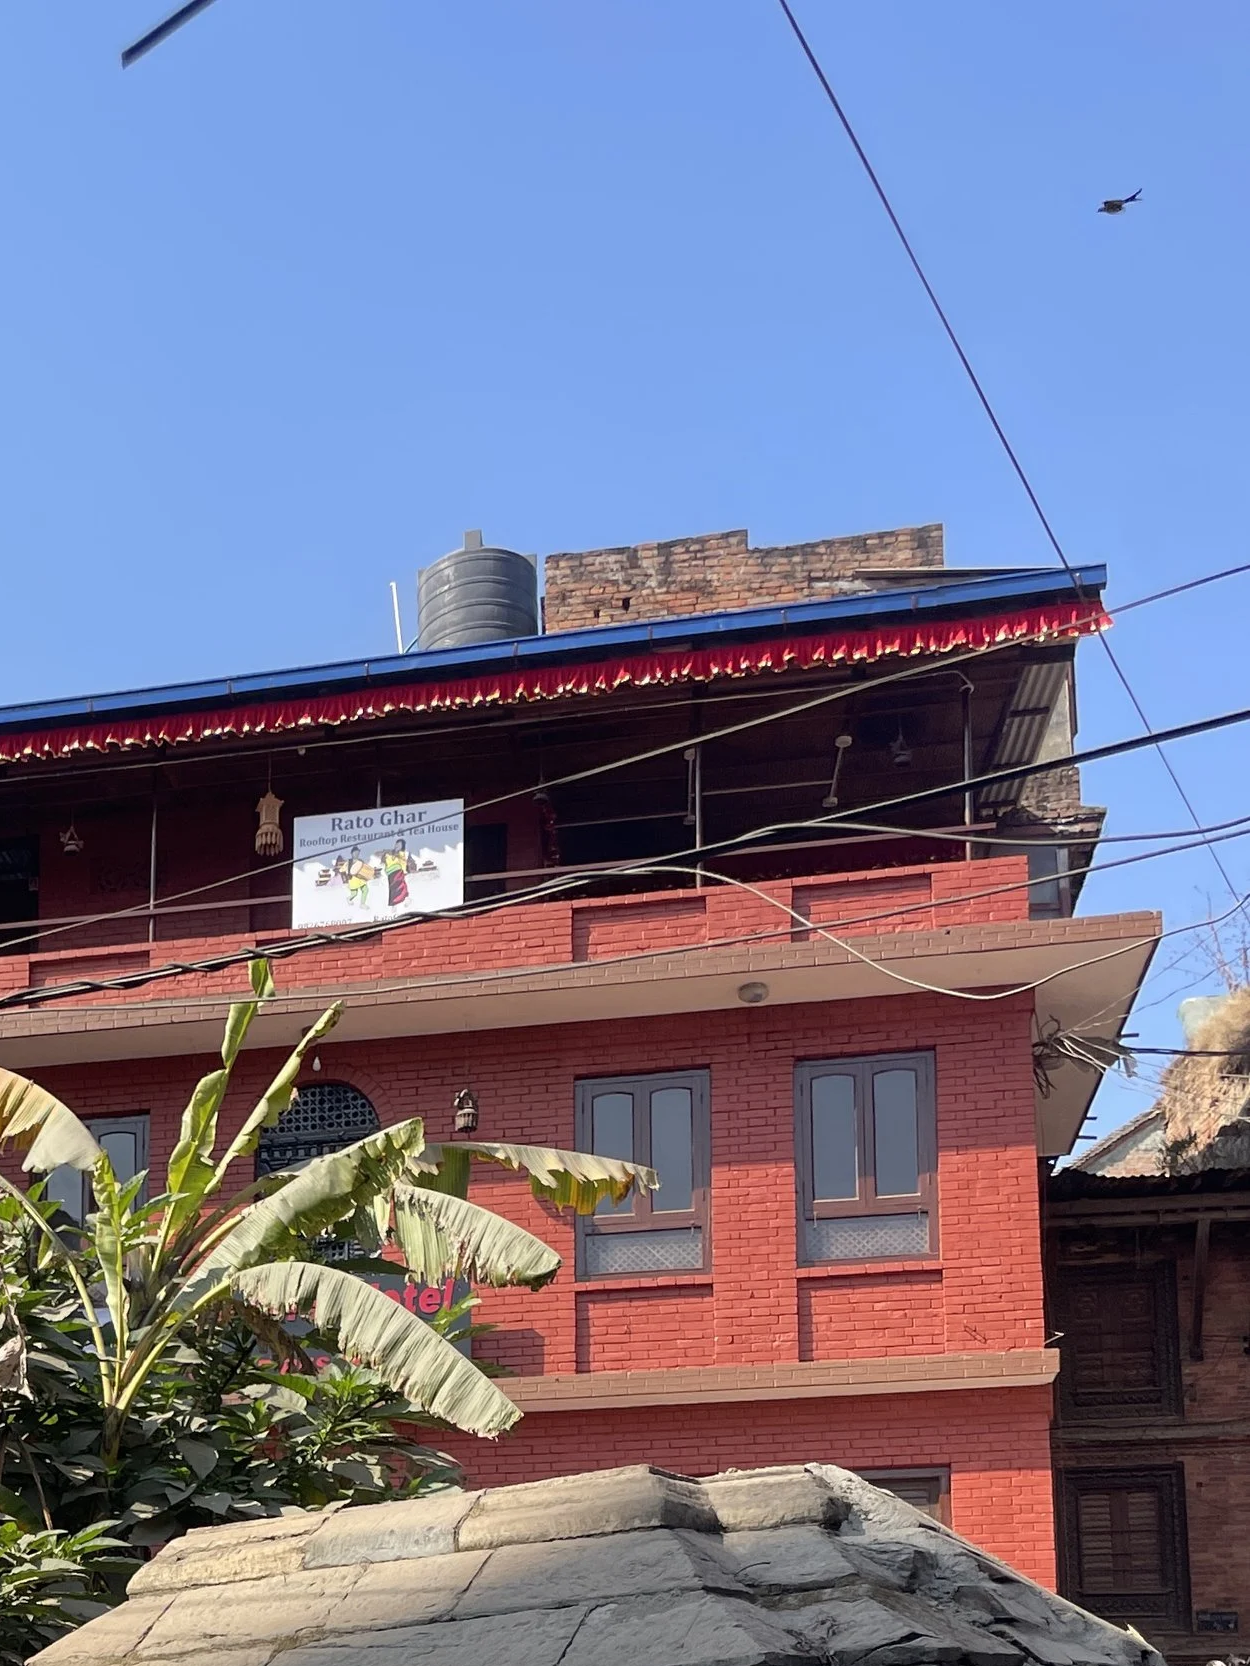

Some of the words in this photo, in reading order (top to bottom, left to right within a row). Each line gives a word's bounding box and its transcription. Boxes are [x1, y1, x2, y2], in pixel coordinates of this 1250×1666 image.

[331, 816, 374, 832] Rato
[380, 810, 428, 828] Ghar
[299, 837, 338, 848] Rooftop
[340, 831, 395, 843] Restaurant
[428, 823, 459, 834] House
